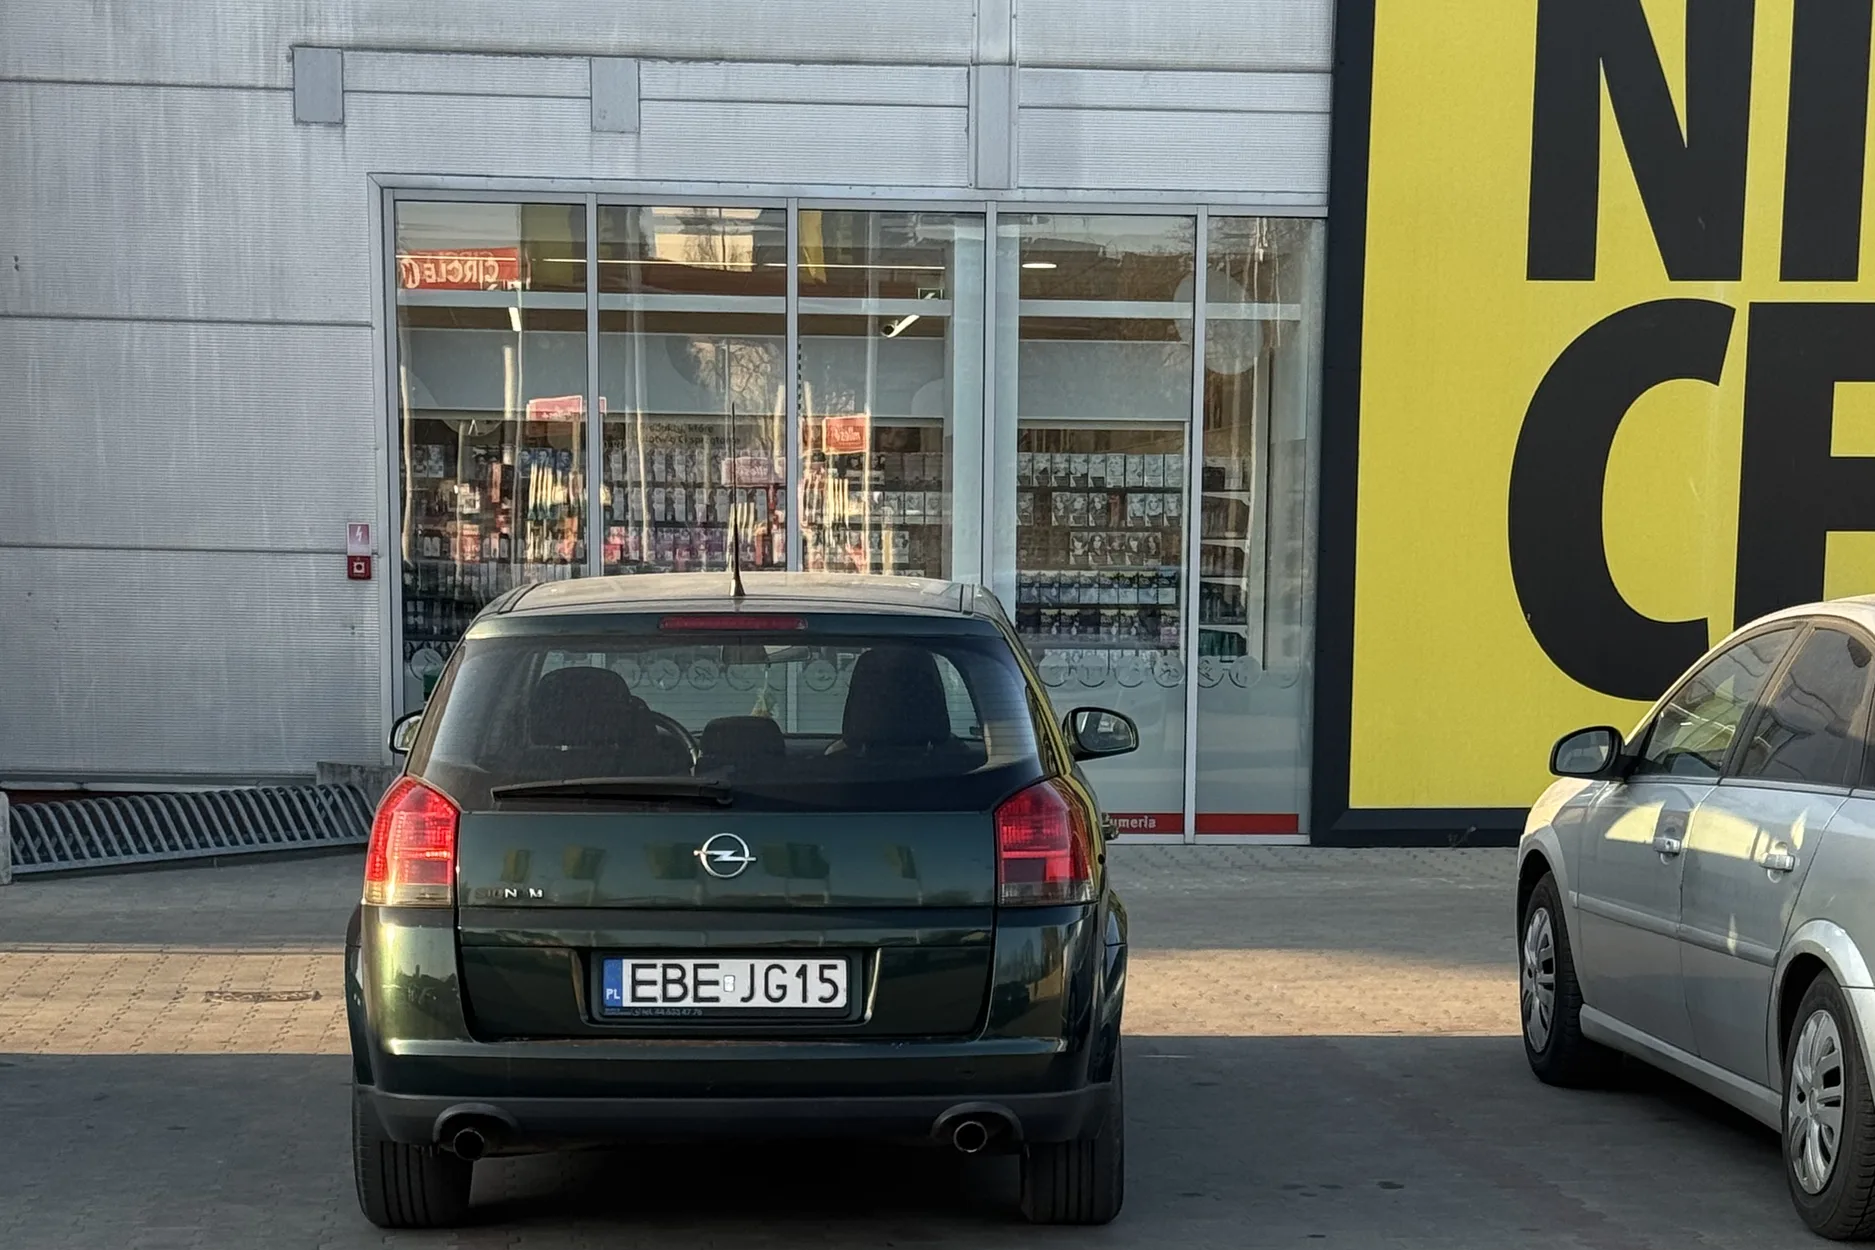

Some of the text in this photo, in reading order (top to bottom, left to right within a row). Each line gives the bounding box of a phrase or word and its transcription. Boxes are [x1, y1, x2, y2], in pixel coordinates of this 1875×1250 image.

[1109, 815, 1157, 829] umeria
[630, 963, 839, 1004] EBE JG15
[606, 988, 621, 1000] PL
